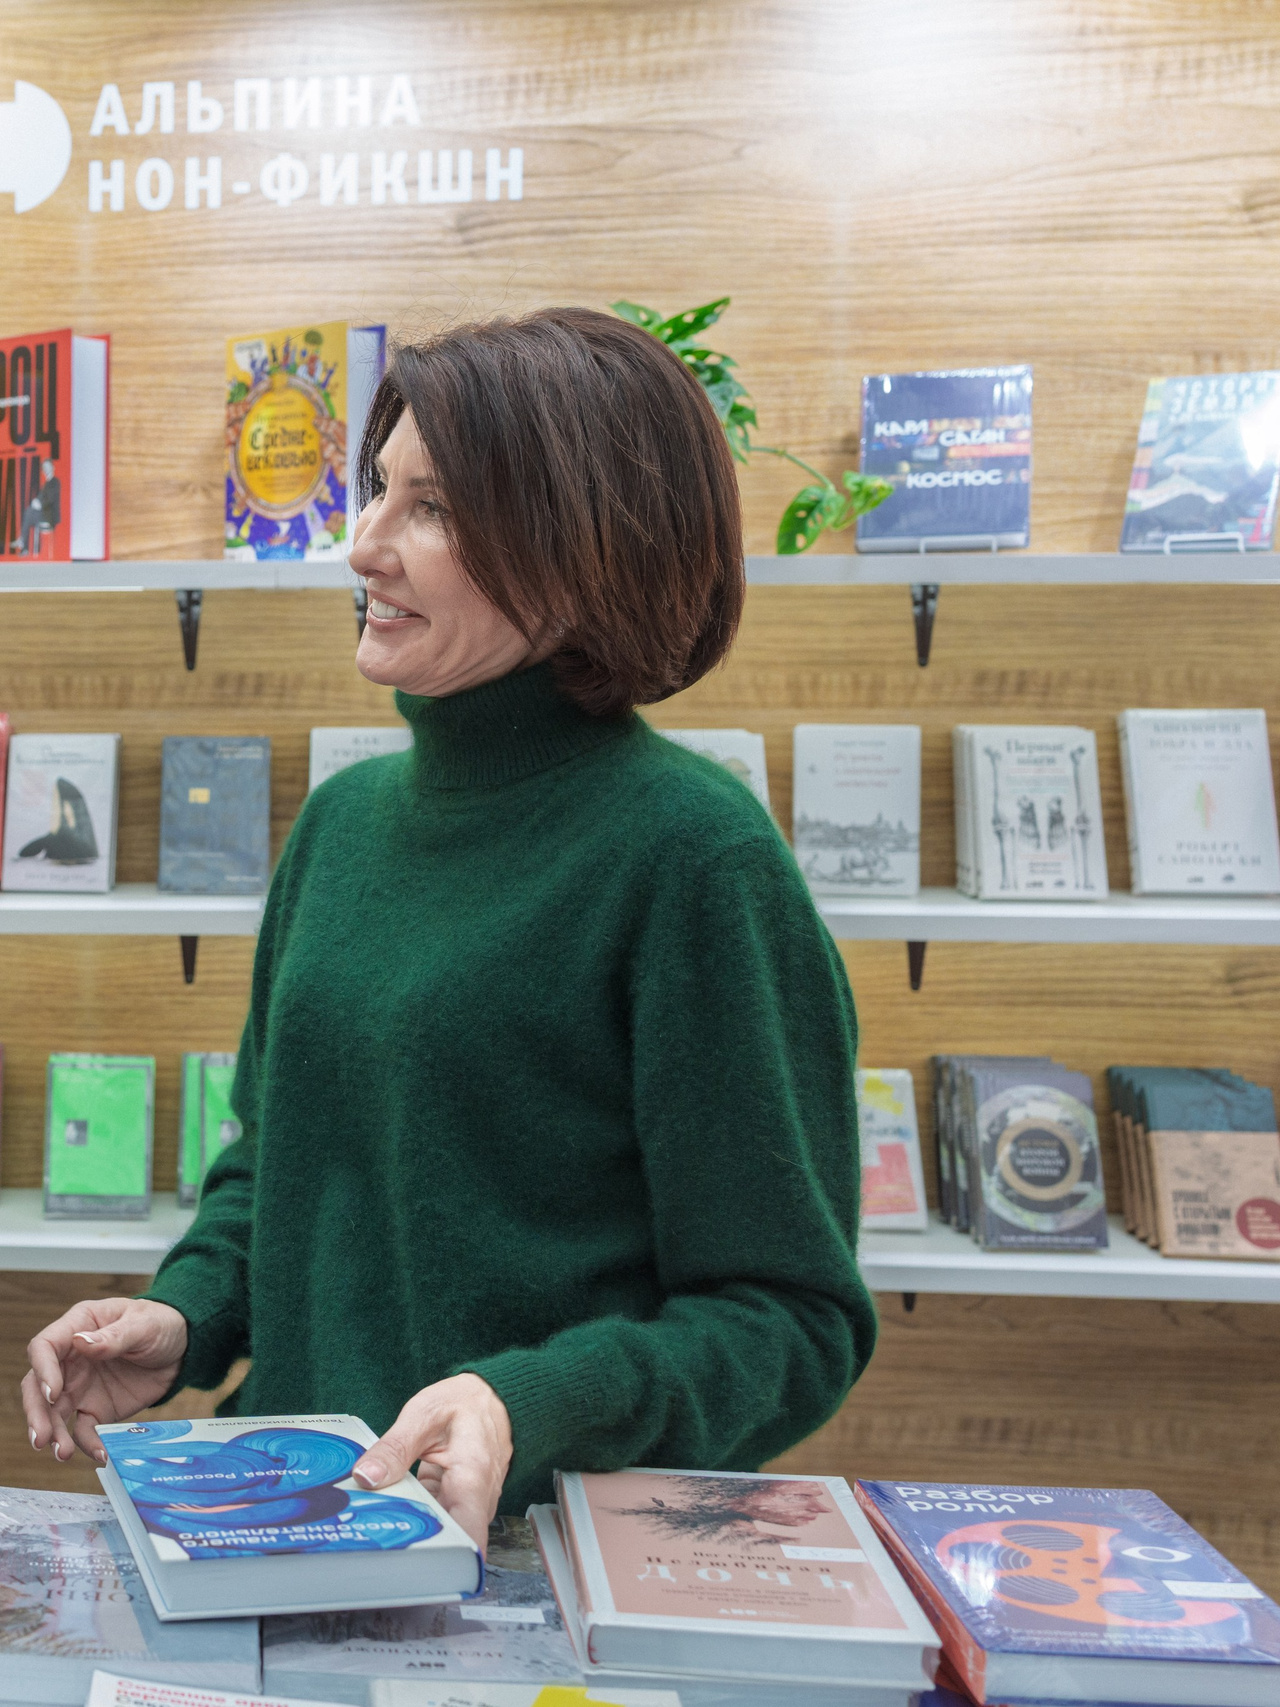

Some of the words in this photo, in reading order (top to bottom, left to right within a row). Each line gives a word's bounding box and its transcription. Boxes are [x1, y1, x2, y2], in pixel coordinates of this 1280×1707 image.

[91, 74, 422, 137] АЛЬПИНА
[88, 147, 524, 213] НОН-ФИКШН
[939, 428, 1005, 447] САГАН
[906, 469, 1003, 489] КОСМОС
[206, 1418, 297, 1428] психоанализа
[300, 1417, 346, 1425] Теория
[151, 1470, 236, 1483] Россохин
[245, 1467, 310, 1480] Андрей
[895, 1485, 1055, 1506] Разбор
[907, 1498, 1017, 1515] роли
[177, 1521, 411, 1541] бессознательного
[290, 1532, 371, 1543] Тайны
[182, 1533, 278, 1549] нашего
